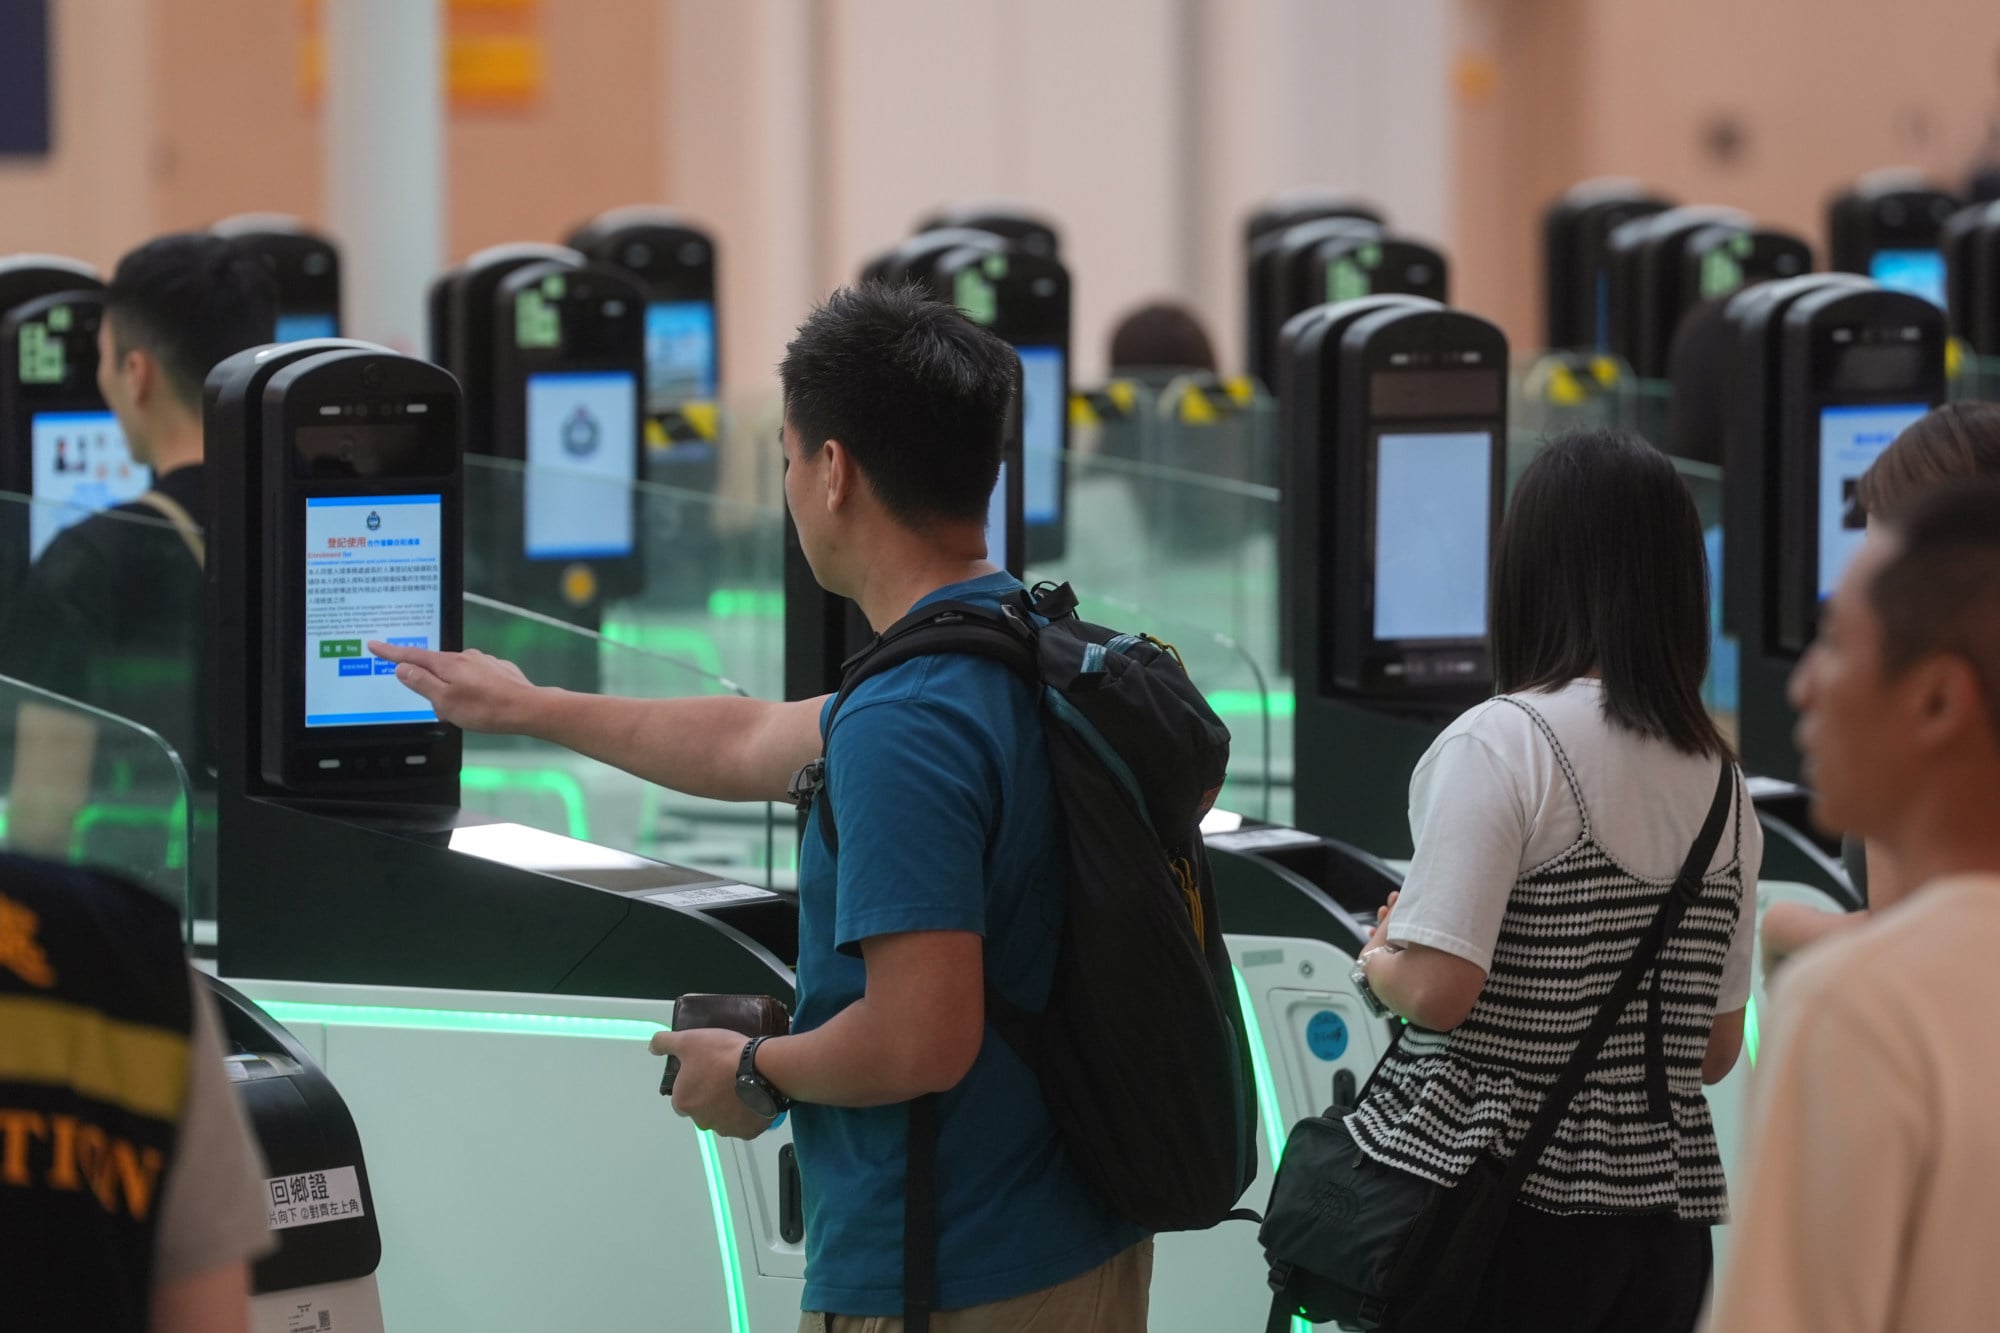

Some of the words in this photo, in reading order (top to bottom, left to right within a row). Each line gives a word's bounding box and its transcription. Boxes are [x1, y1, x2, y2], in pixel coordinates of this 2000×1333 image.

[328, 537, 367, 549] 登記使用
[269, 1173, 330, 1207] 回鄉證
